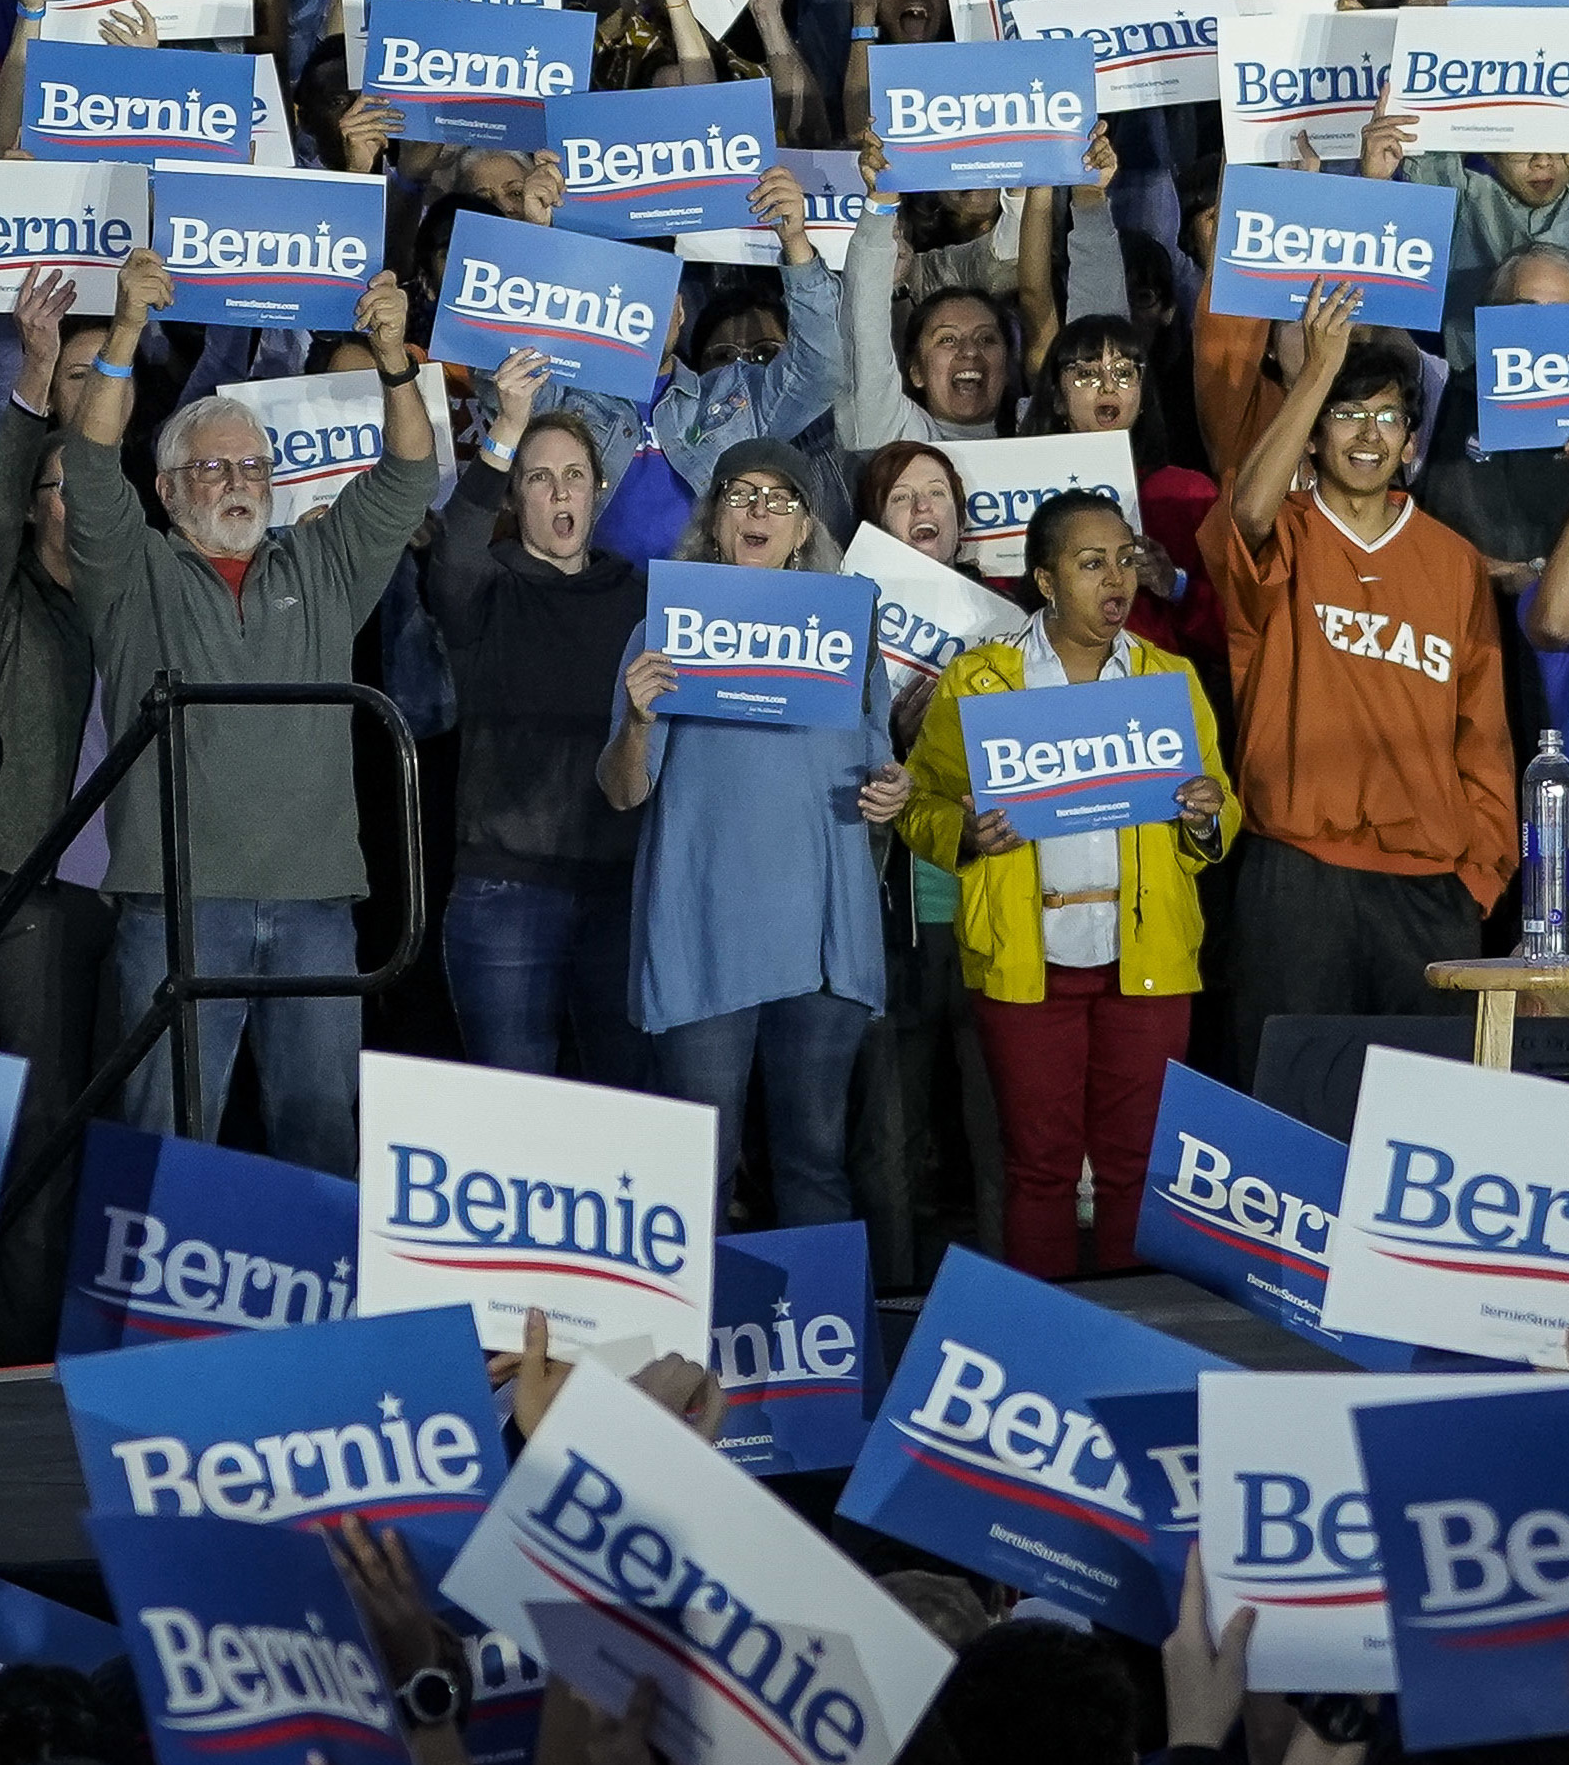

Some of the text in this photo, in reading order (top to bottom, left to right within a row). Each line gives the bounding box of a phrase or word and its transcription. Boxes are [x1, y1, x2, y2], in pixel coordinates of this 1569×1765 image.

[377, 37, 574, 96] Bernie
[37, 82, 235, 138] Bernie
[887, 78, 1082, 135] Bernie
[562, 123, 761, 186] Bernie
[168, 219, 367, 280] Bernie
[1231, 210, 1434, 279] Bernie
[456, 256, 654, 346] Bernie
[662, 606, 853, 675] Bernie
[981, 717, 1183, 788] Bernie
[387, 1142, 688, 1275] Bernie
[1169, 1132, 1338, 1265] Ber
[94, 1205, 357, 1329] Berni
[714, 1298, 857, 1388] nie
[536, 1448, 865, 1764] Bernie
[141, 1607, 391, 1730] Bernie
